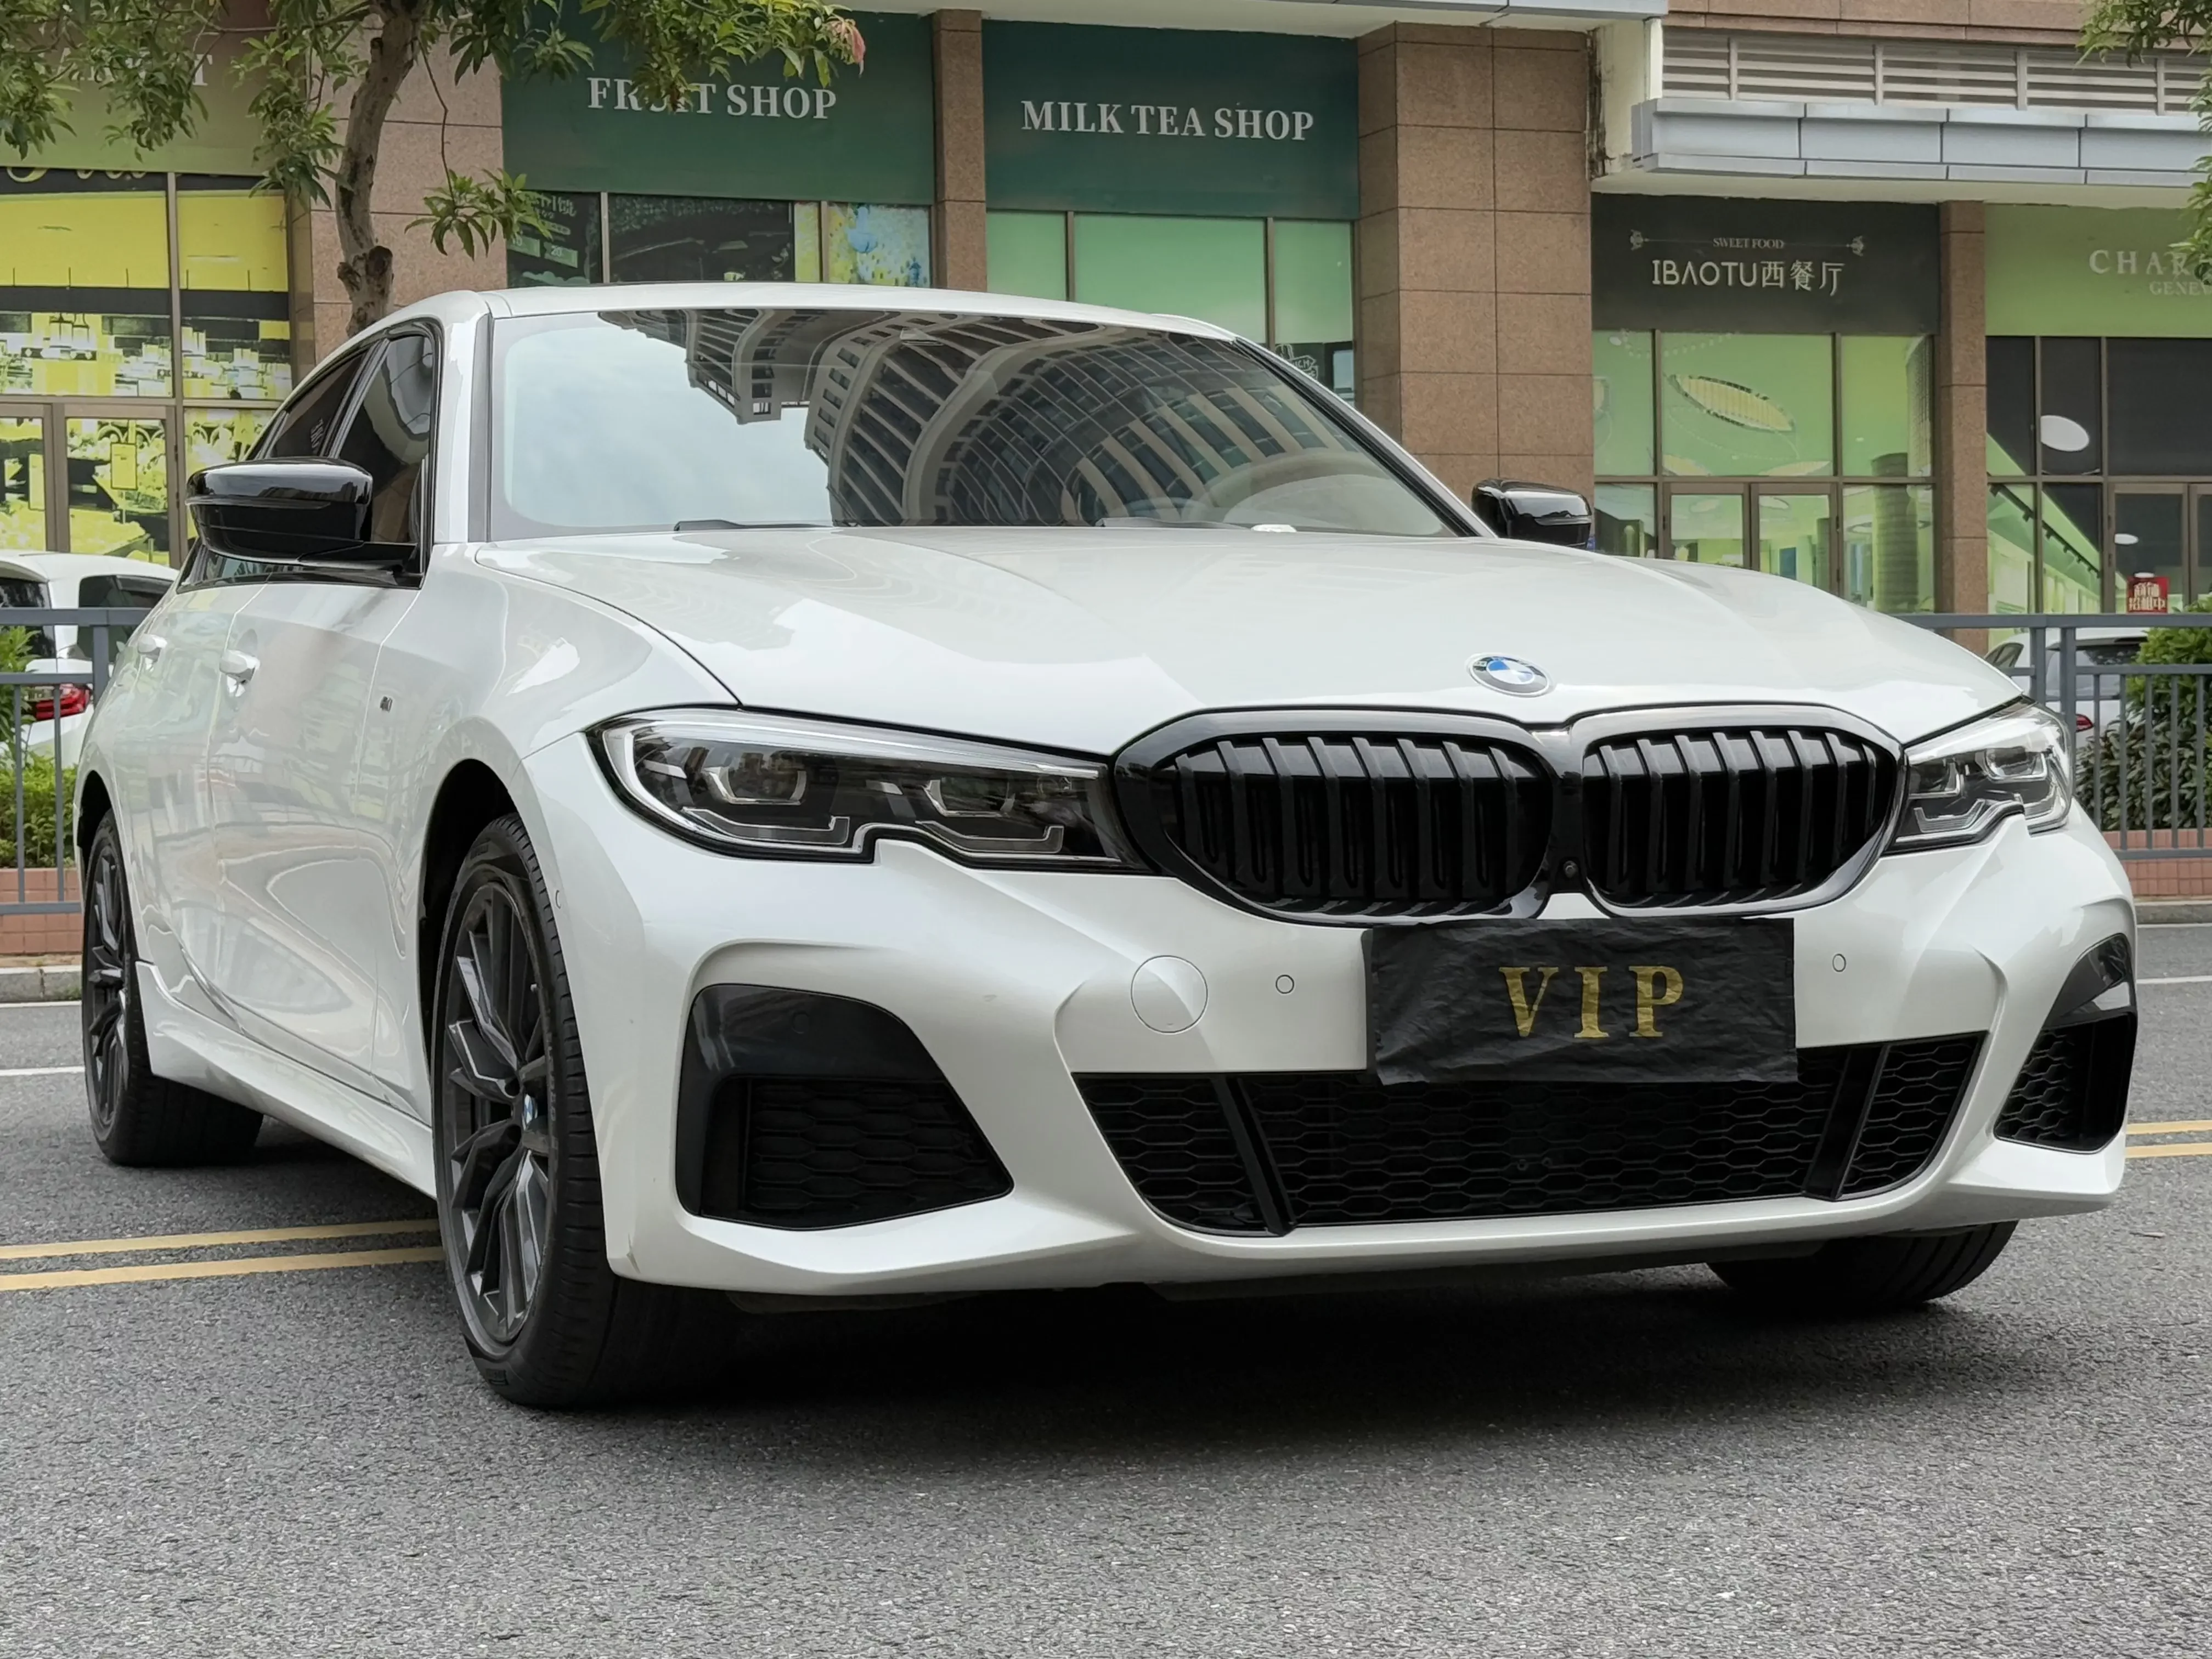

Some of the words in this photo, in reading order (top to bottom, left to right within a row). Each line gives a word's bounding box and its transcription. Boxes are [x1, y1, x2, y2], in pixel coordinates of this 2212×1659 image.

[727, 84, 837, 119] SHOP
[1021, 100, 1125, 133] MILK
[1131, 105, 1206, 136] TEA
[1215, 108, 1313, 140] SHOP
[1713, 237, 1750, 249] SWEET
[1752, 238, 1785, 249] FOOD
[1498, 966, 1683, 1038] VIP
